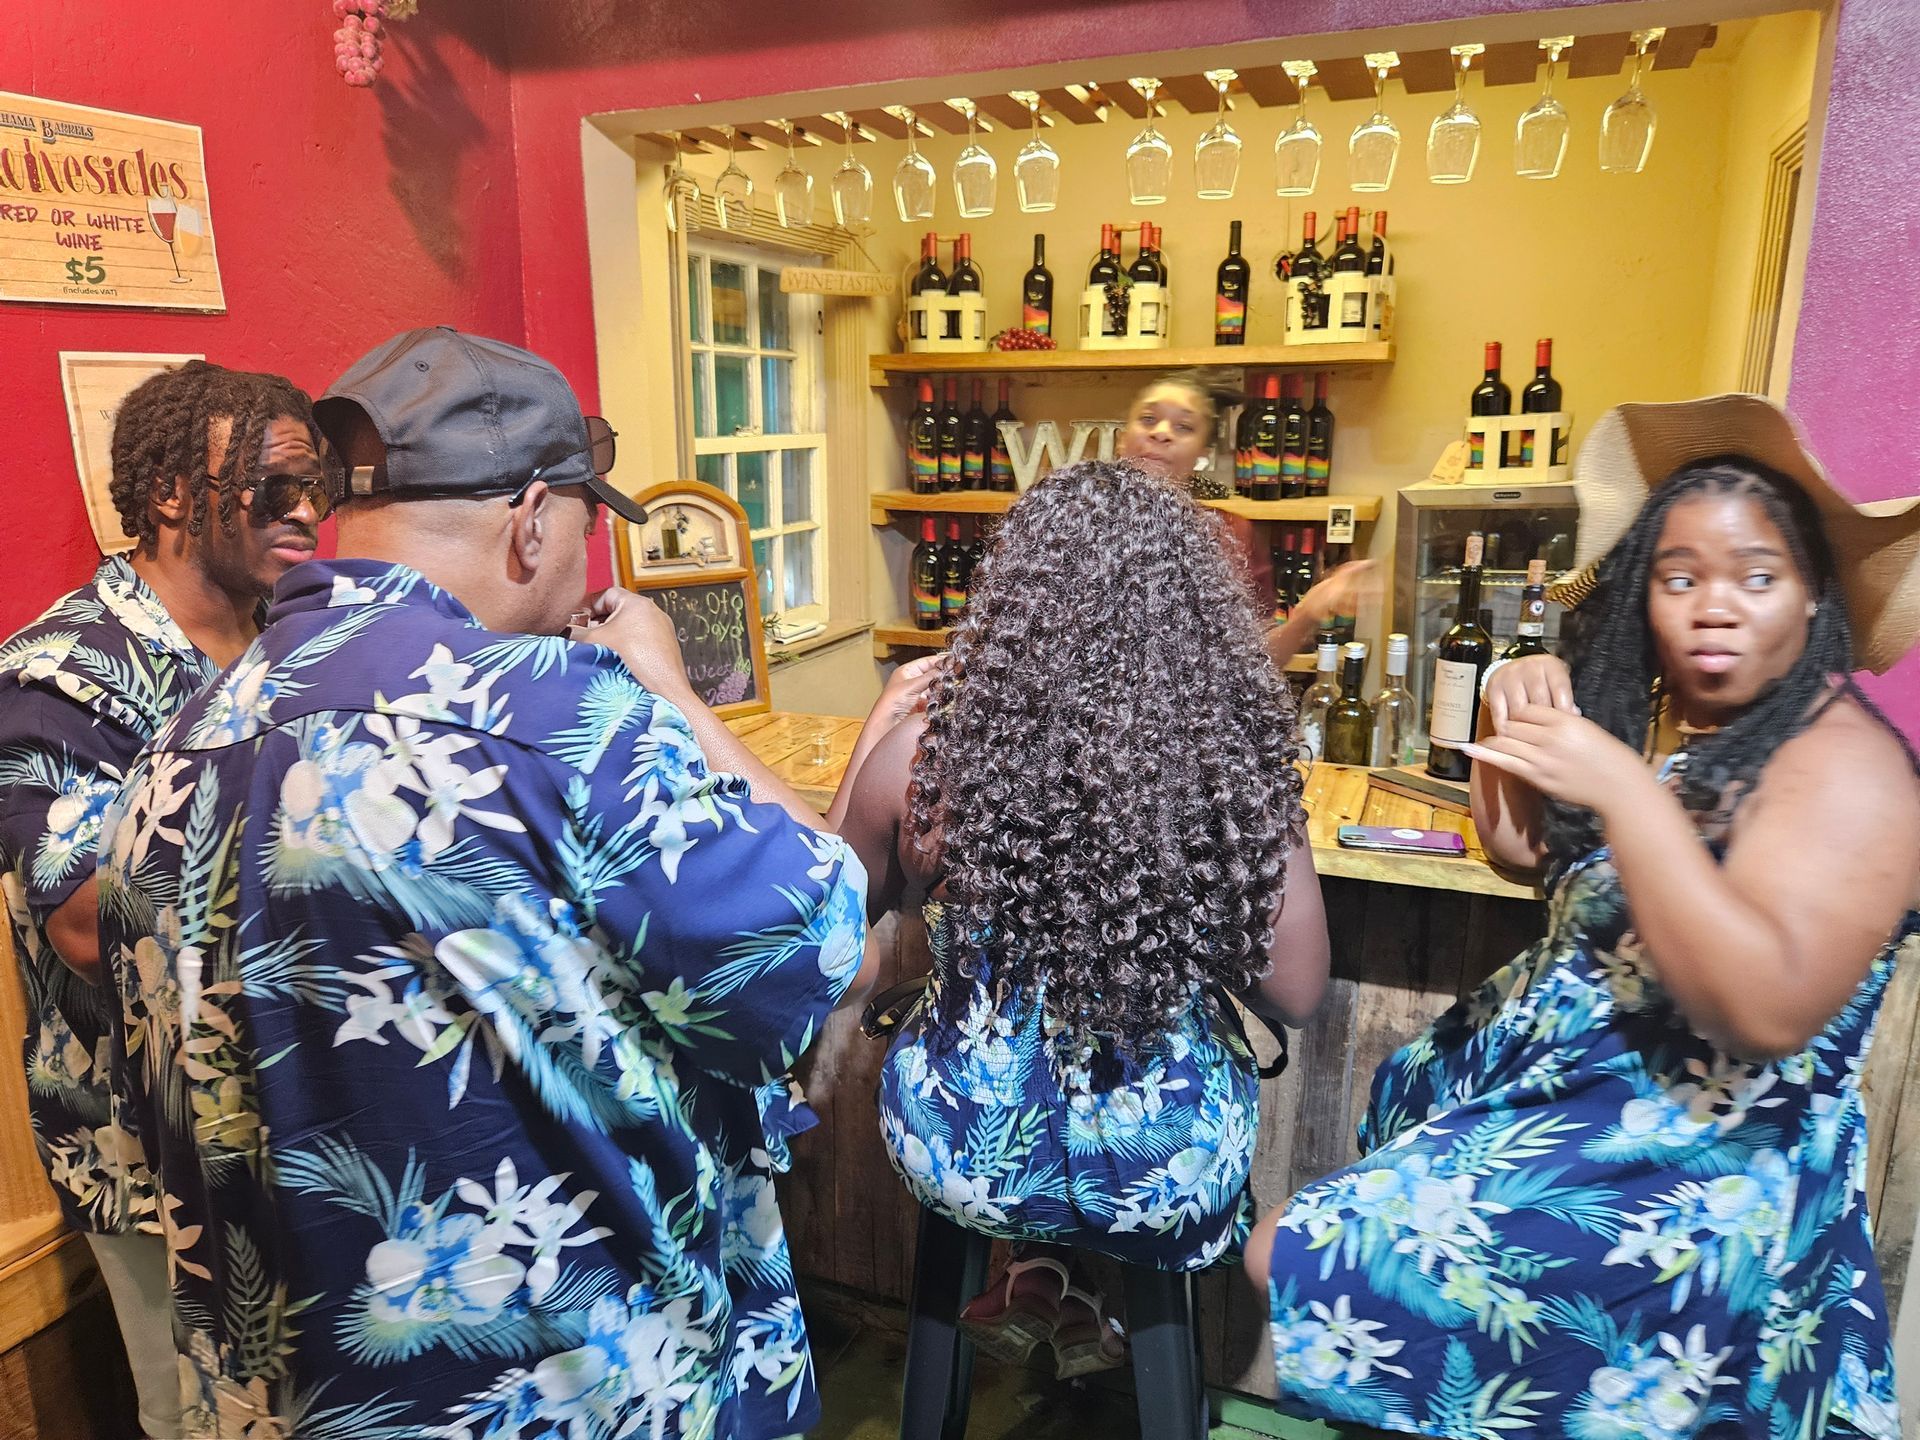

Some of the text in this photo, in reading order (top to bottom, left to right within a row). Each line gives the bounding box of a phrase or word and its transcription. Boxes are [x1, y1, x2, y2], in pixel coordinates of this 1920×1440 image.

[0, 203, 146, 234] RED OR WHITE
[55, 232, 103, 252] WINE
[65, 255, 106, 285] $5
[787, 271, 893, 293] WINE TASTING
[686, 662, 732, 681] weet
